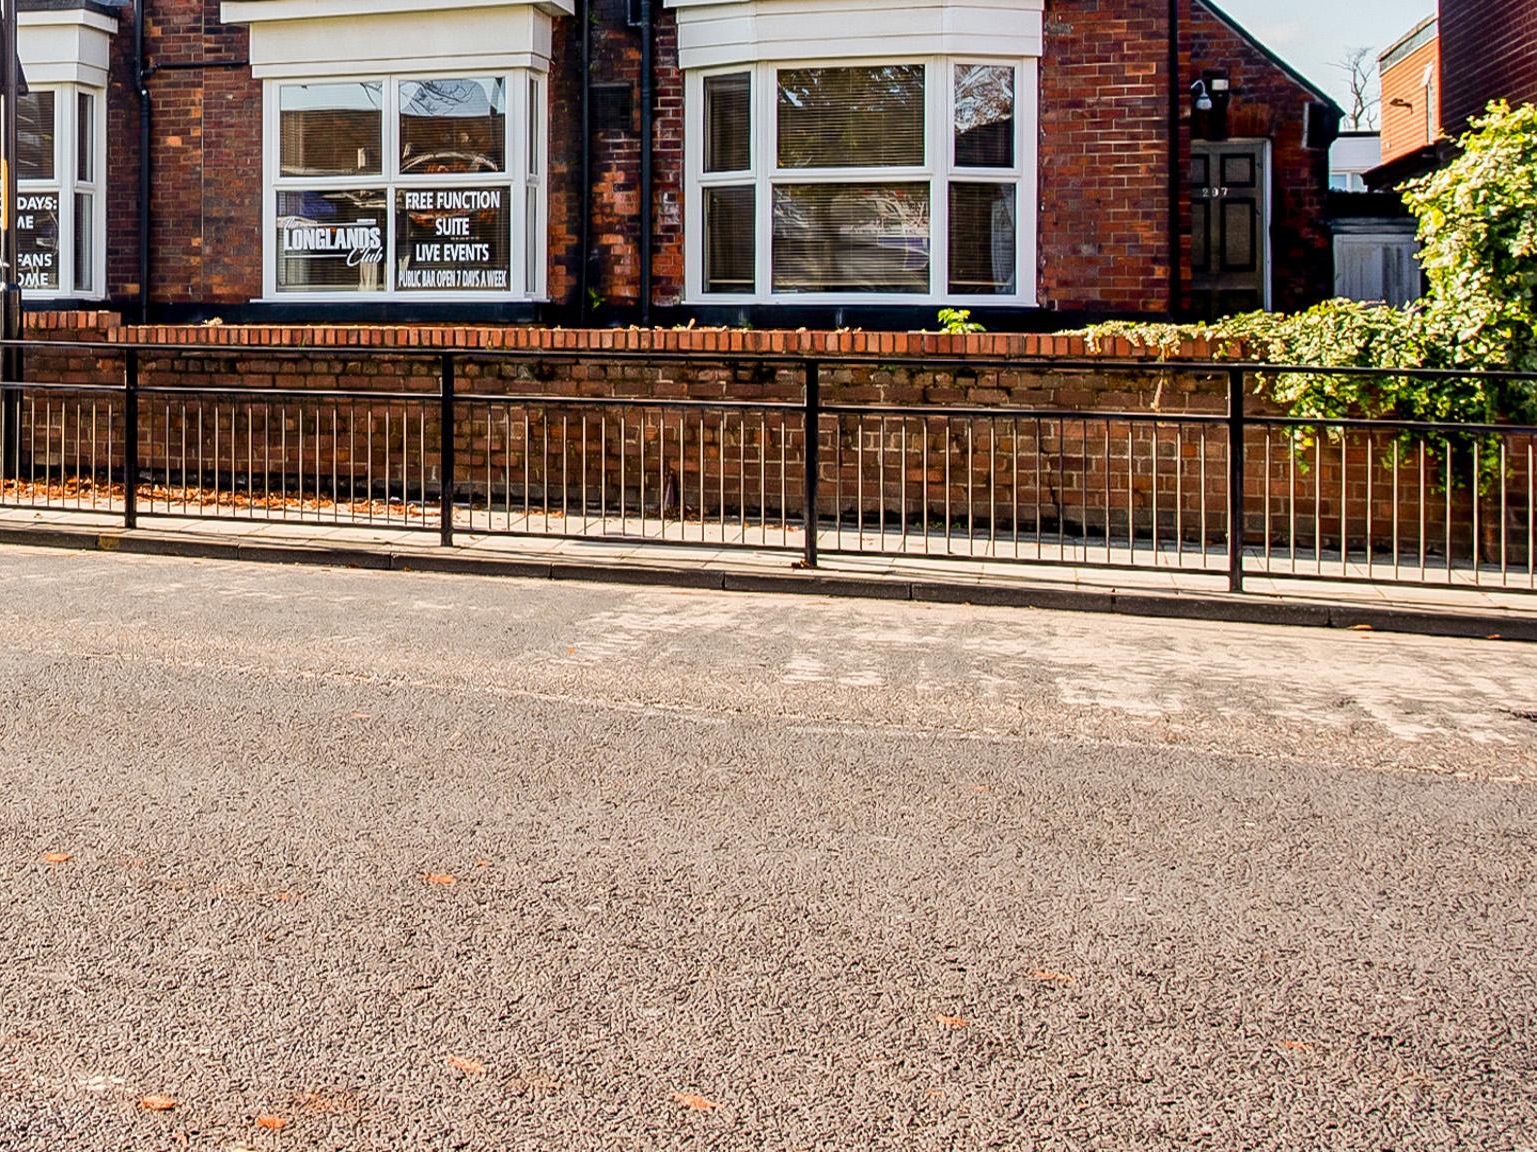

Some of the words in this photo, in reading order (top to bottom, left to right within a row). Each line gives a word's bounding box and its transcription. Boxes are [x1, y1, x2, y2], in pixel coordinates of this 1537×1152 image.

[405, 191, 434, 210] FREE
[436, 190, 501, 209] FUNCTION
[435, 217, 470, 236] SUITE
[283, 227, 381, 250] LONGLANDS
[346, 246, 383, 267] Club
[416, 243, 441, 262] LIVE
[443, 243, 490, 262] EVENTS
[398, 270, 422, 288] PUBLIC
[422, 270, 436, 288] BAR
[436, 270, 456, 288] OPEN
[456, 270, 462, 288] 7
[463, 270, 480, 288] DAYS
[480, 270, 487, 288] A
[487, 270, 508, 288] WEEK
